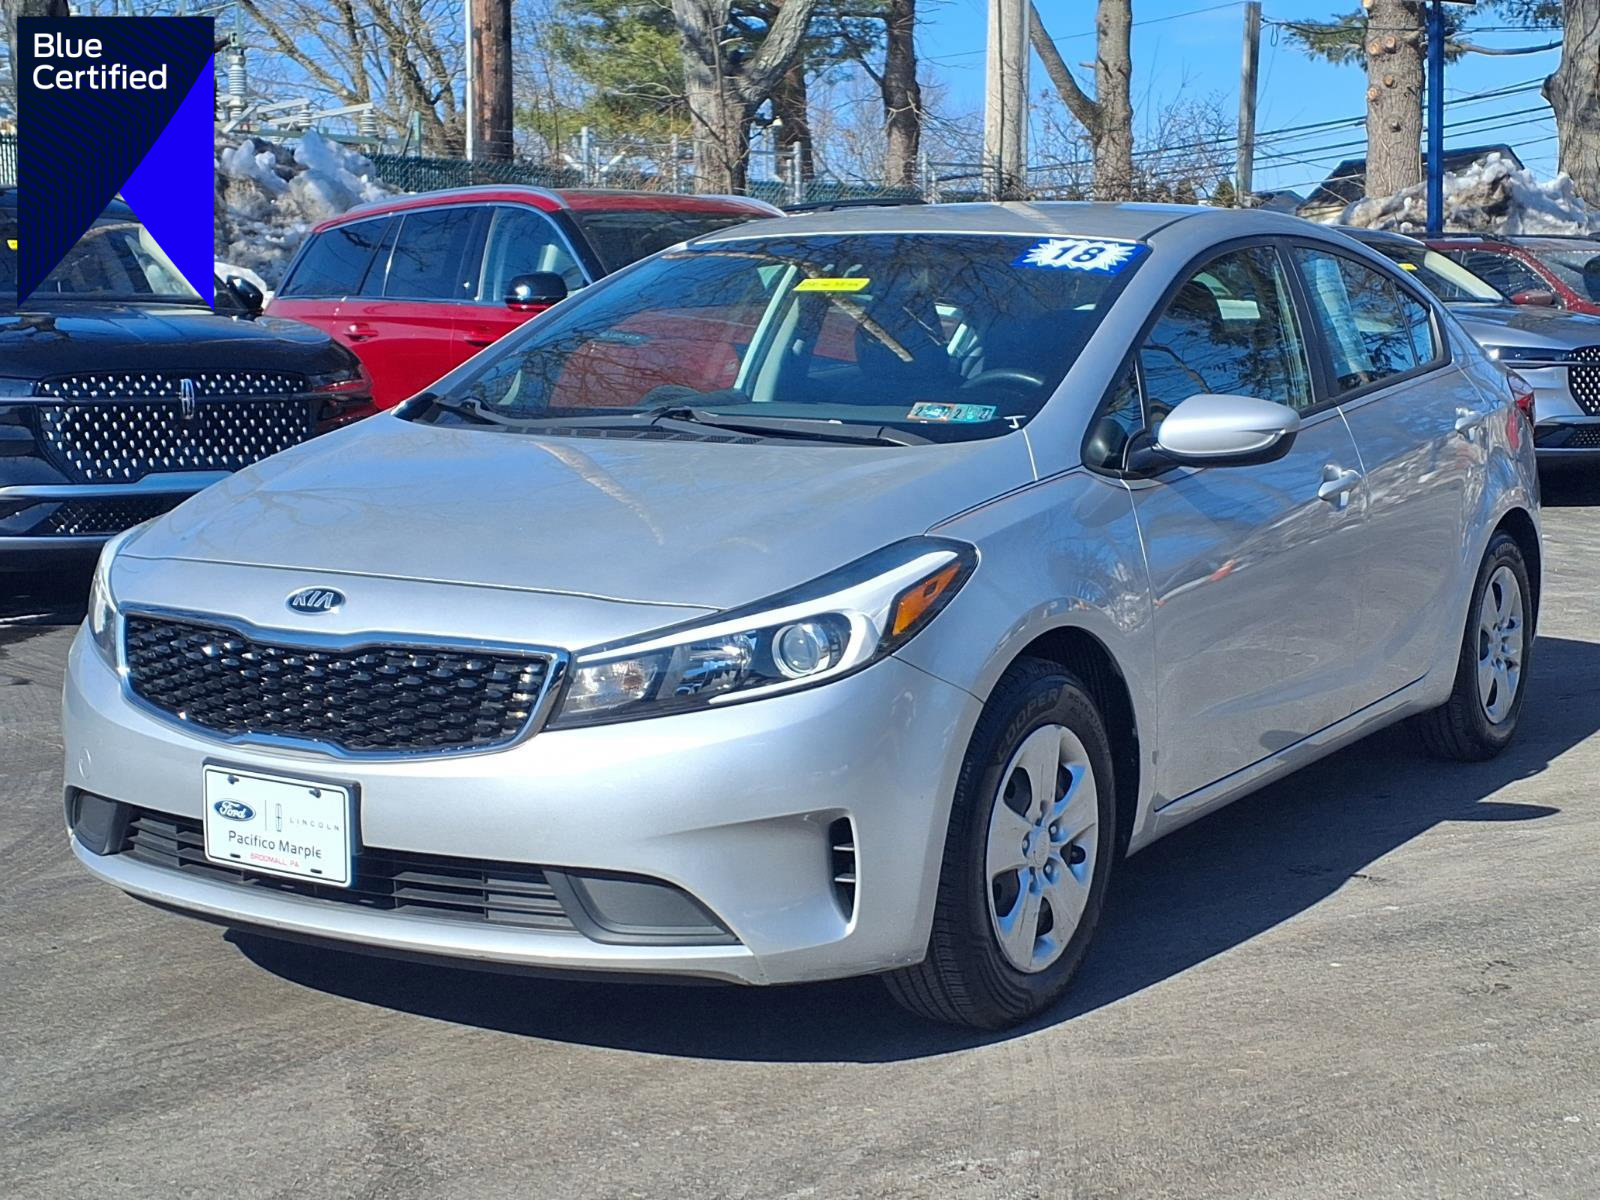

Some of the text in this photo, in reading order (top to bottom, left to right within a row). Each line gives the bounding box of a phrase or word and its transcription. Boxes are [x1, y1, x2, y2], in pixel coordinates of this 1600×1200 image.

[1051, 244, 1105, 263] 18
[292, 590, 334, 608] KIA
[219, 800, 340, 831] Ford LINCOLN
[228, 830, 323, 859] Pacifico Marple
